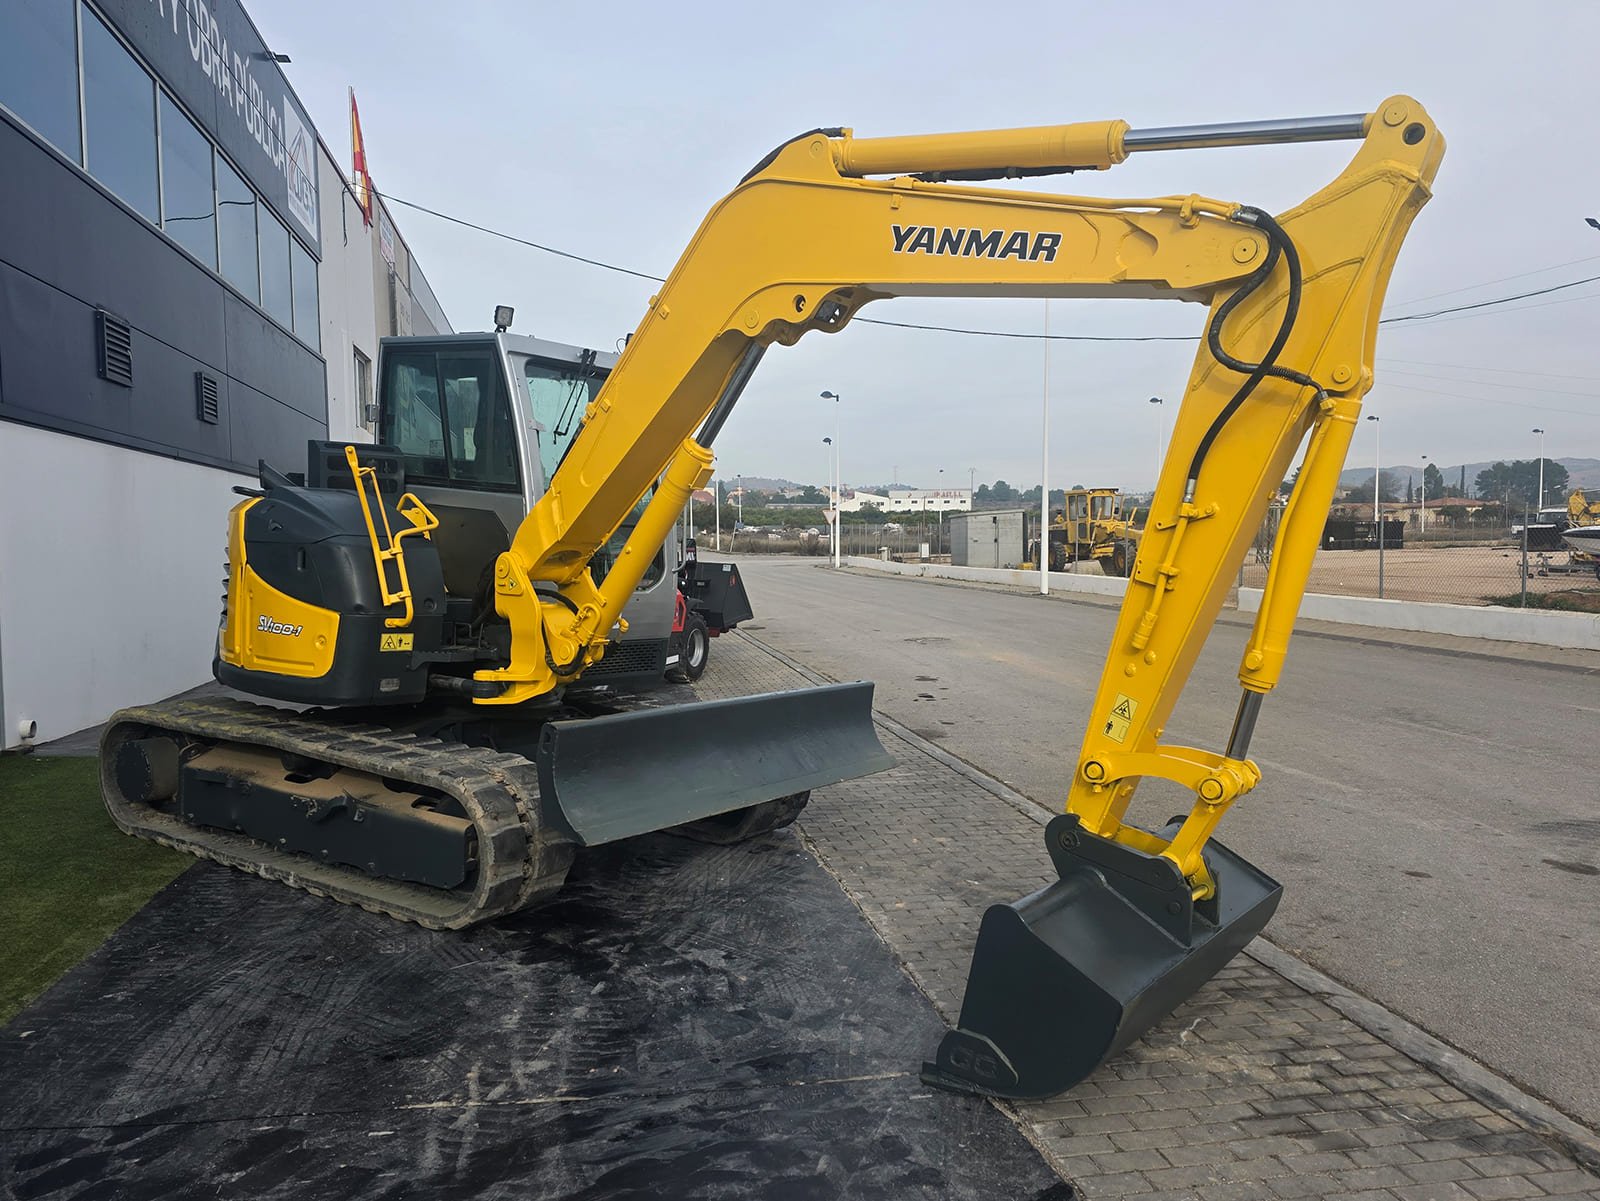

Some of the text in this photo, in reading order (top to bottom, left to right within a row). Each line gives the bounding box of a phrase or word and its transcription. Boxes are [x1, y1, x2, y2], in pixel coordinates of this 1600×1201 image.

[186, 0, 287, 178] OBRA PÚBLICA
[891, 224, 1062, 263] YANMAR
